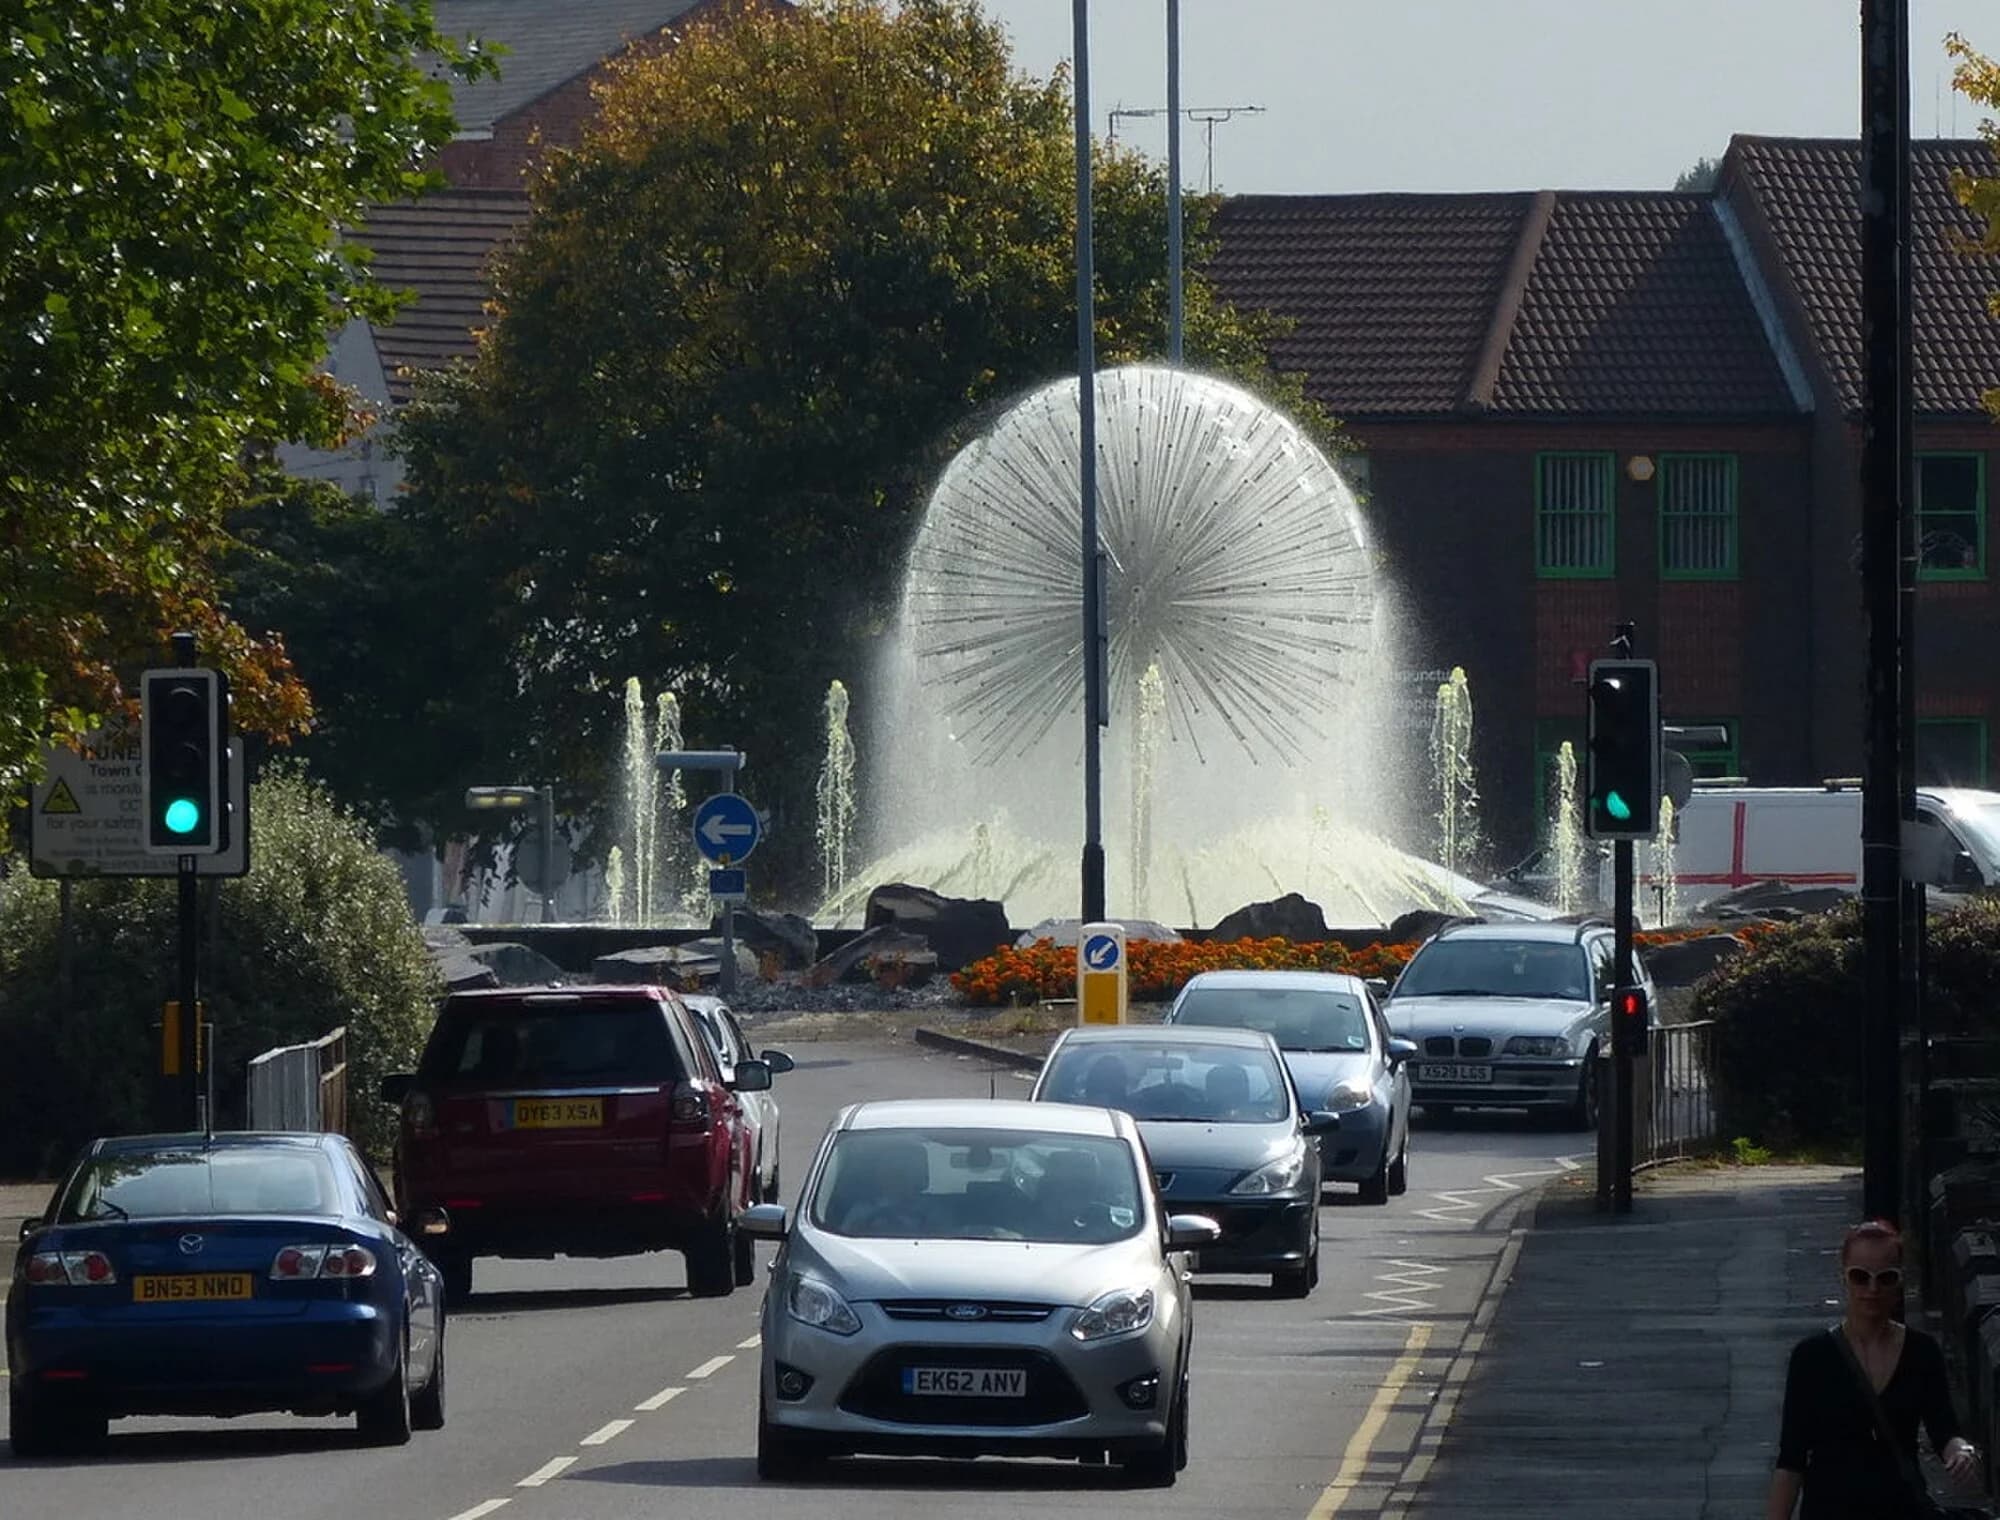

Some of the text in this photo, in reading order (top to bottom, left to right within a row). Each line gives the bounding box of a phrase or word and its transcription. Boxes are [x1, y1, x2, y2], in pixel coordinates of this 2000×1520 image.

[88, 763, 131, 778] Town
[119, 800, 142, 812] CCT
[70, 819, 99, 832] your
[567, 1103, 600, 1120] XSA
[143, 1278, 197, 1299] BN53
[917, 1371, 1022, 1393] EK62 ANV
